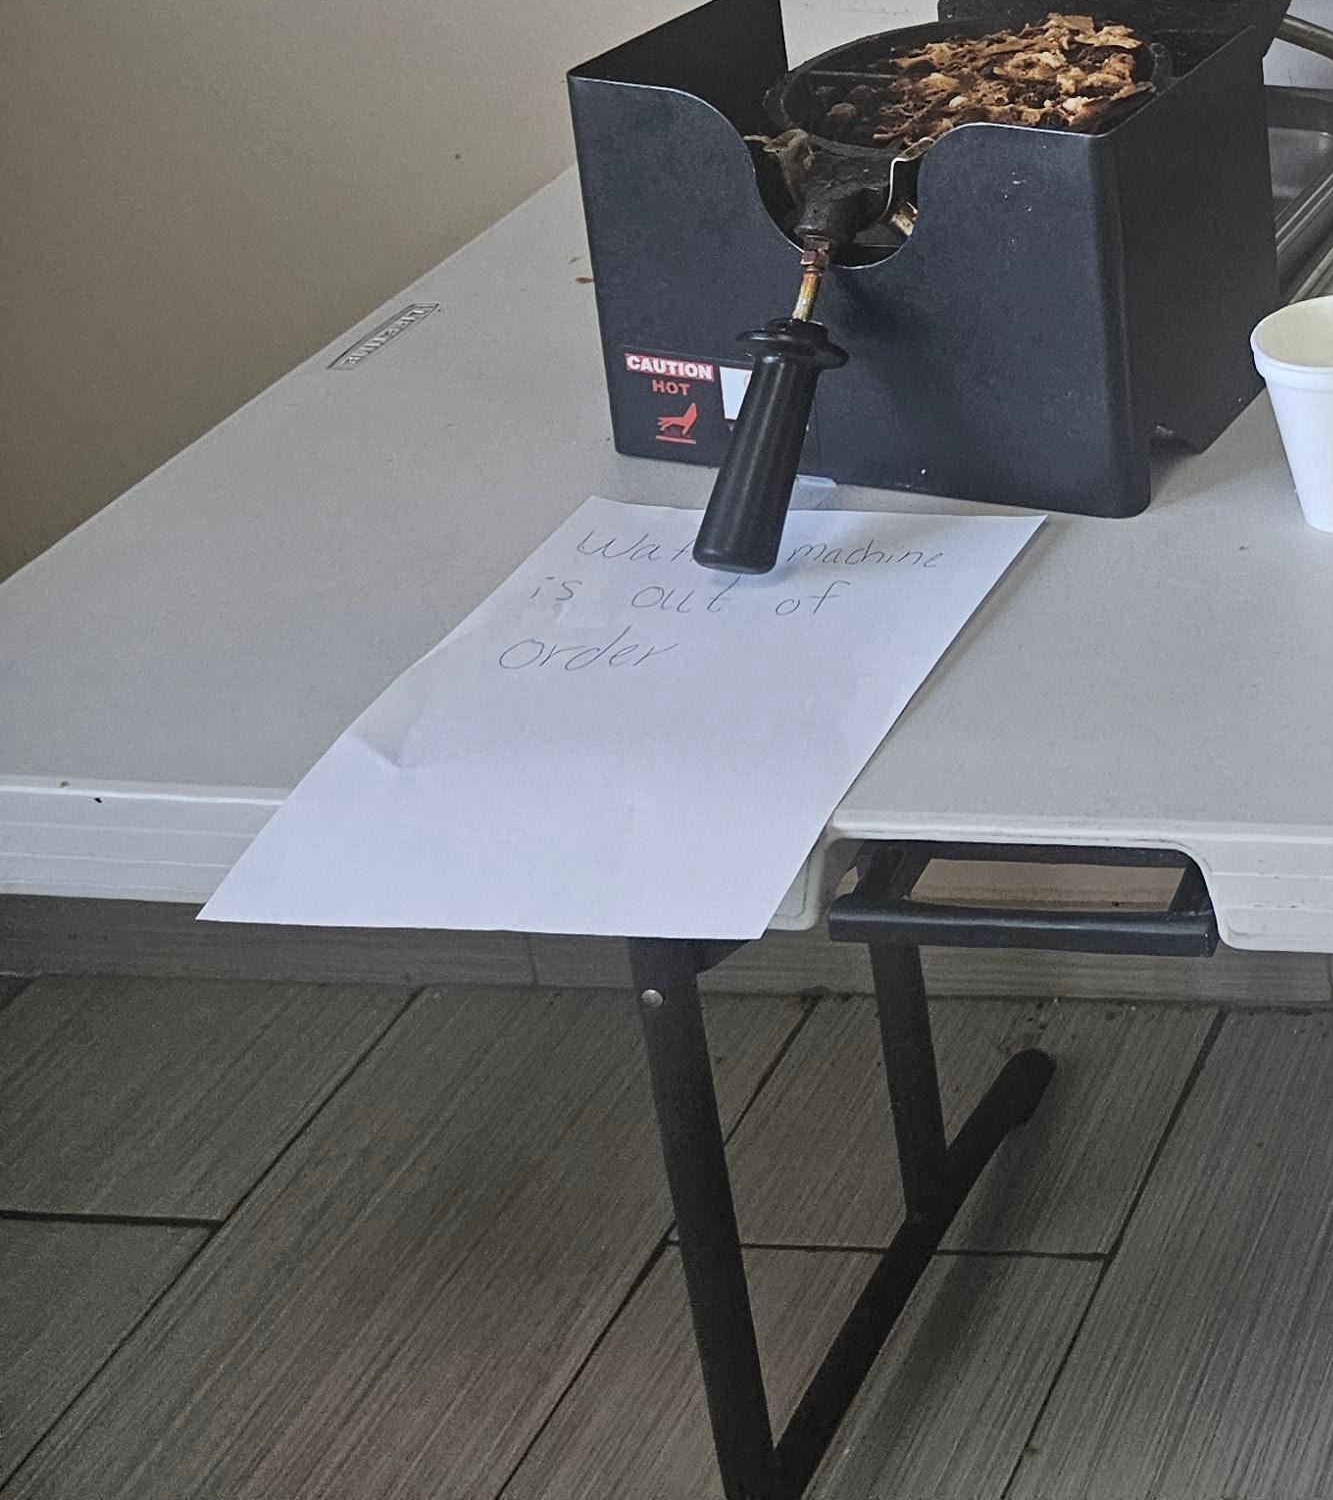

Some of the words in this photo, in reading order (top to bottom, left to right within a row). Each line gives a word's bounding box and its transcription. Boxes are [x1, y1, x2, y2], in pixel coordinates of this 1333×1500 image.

[625, 354, 713, 380] CAUTION
[652, 379, 690, 396] HOT
[530, 574, 583, 602] is
[774, 579, 851, 616] of
